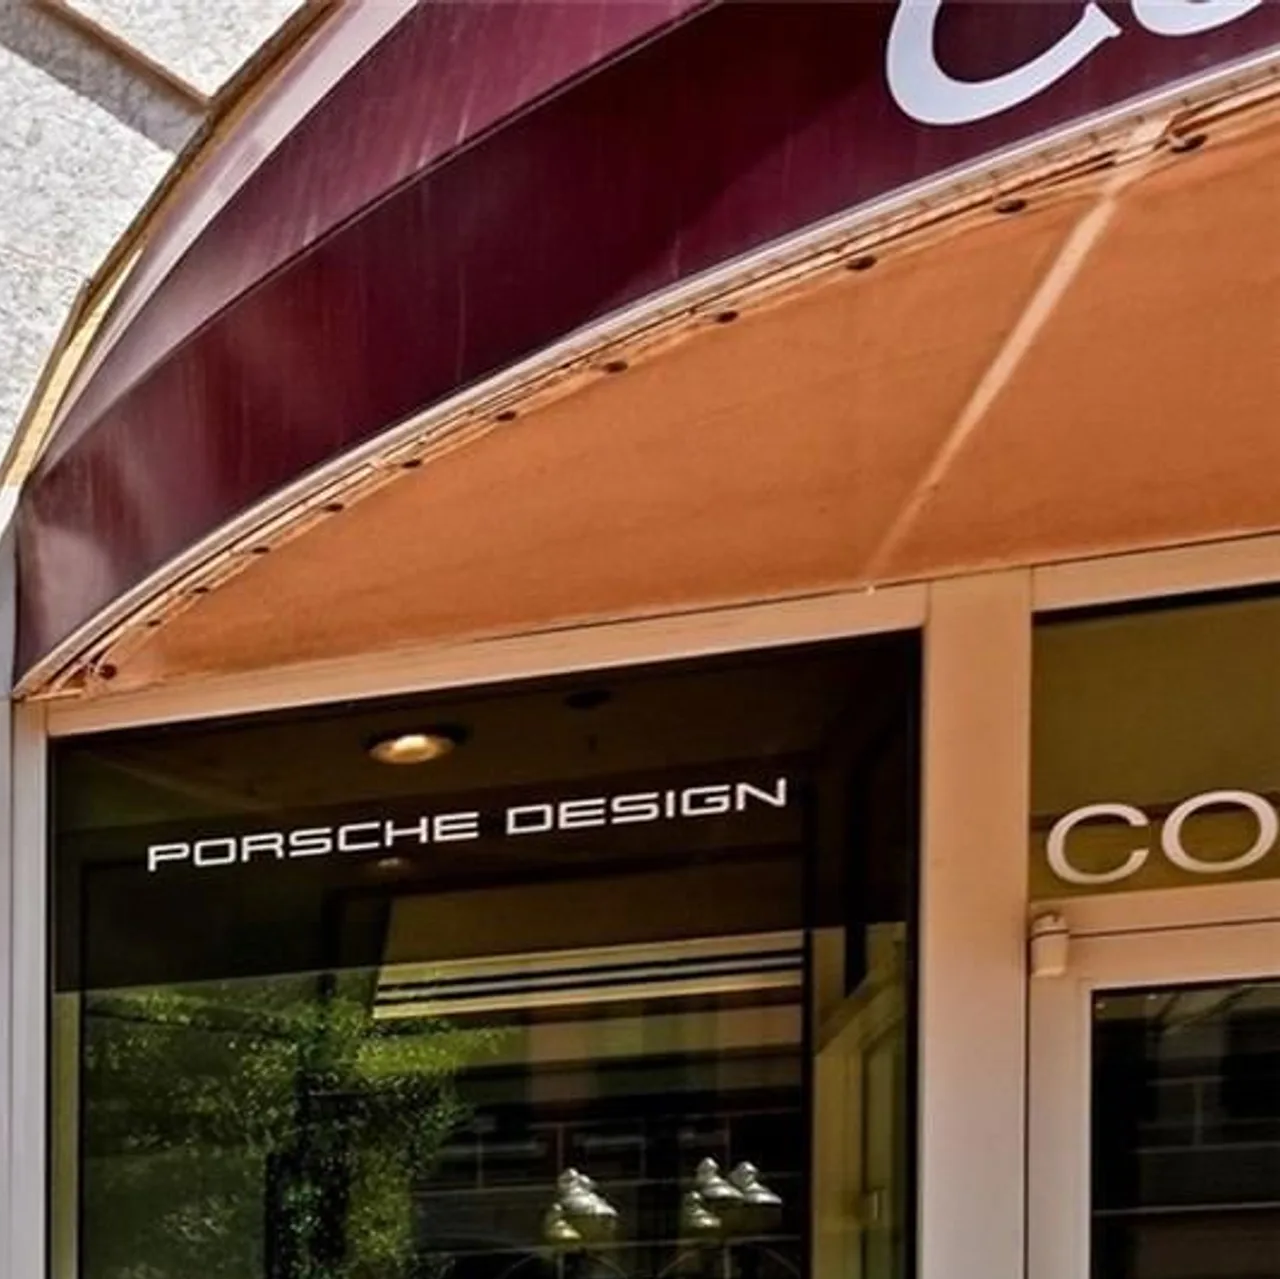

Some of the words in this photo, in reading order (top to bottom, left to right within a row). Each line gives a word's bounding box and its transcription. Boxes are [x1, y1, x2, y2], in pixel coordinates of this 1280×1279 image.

[147, 812, 480, 872] PORSCHE
[506, 777, 787, 835] DESIGN
[1046, 790, 1279, 884] CO
